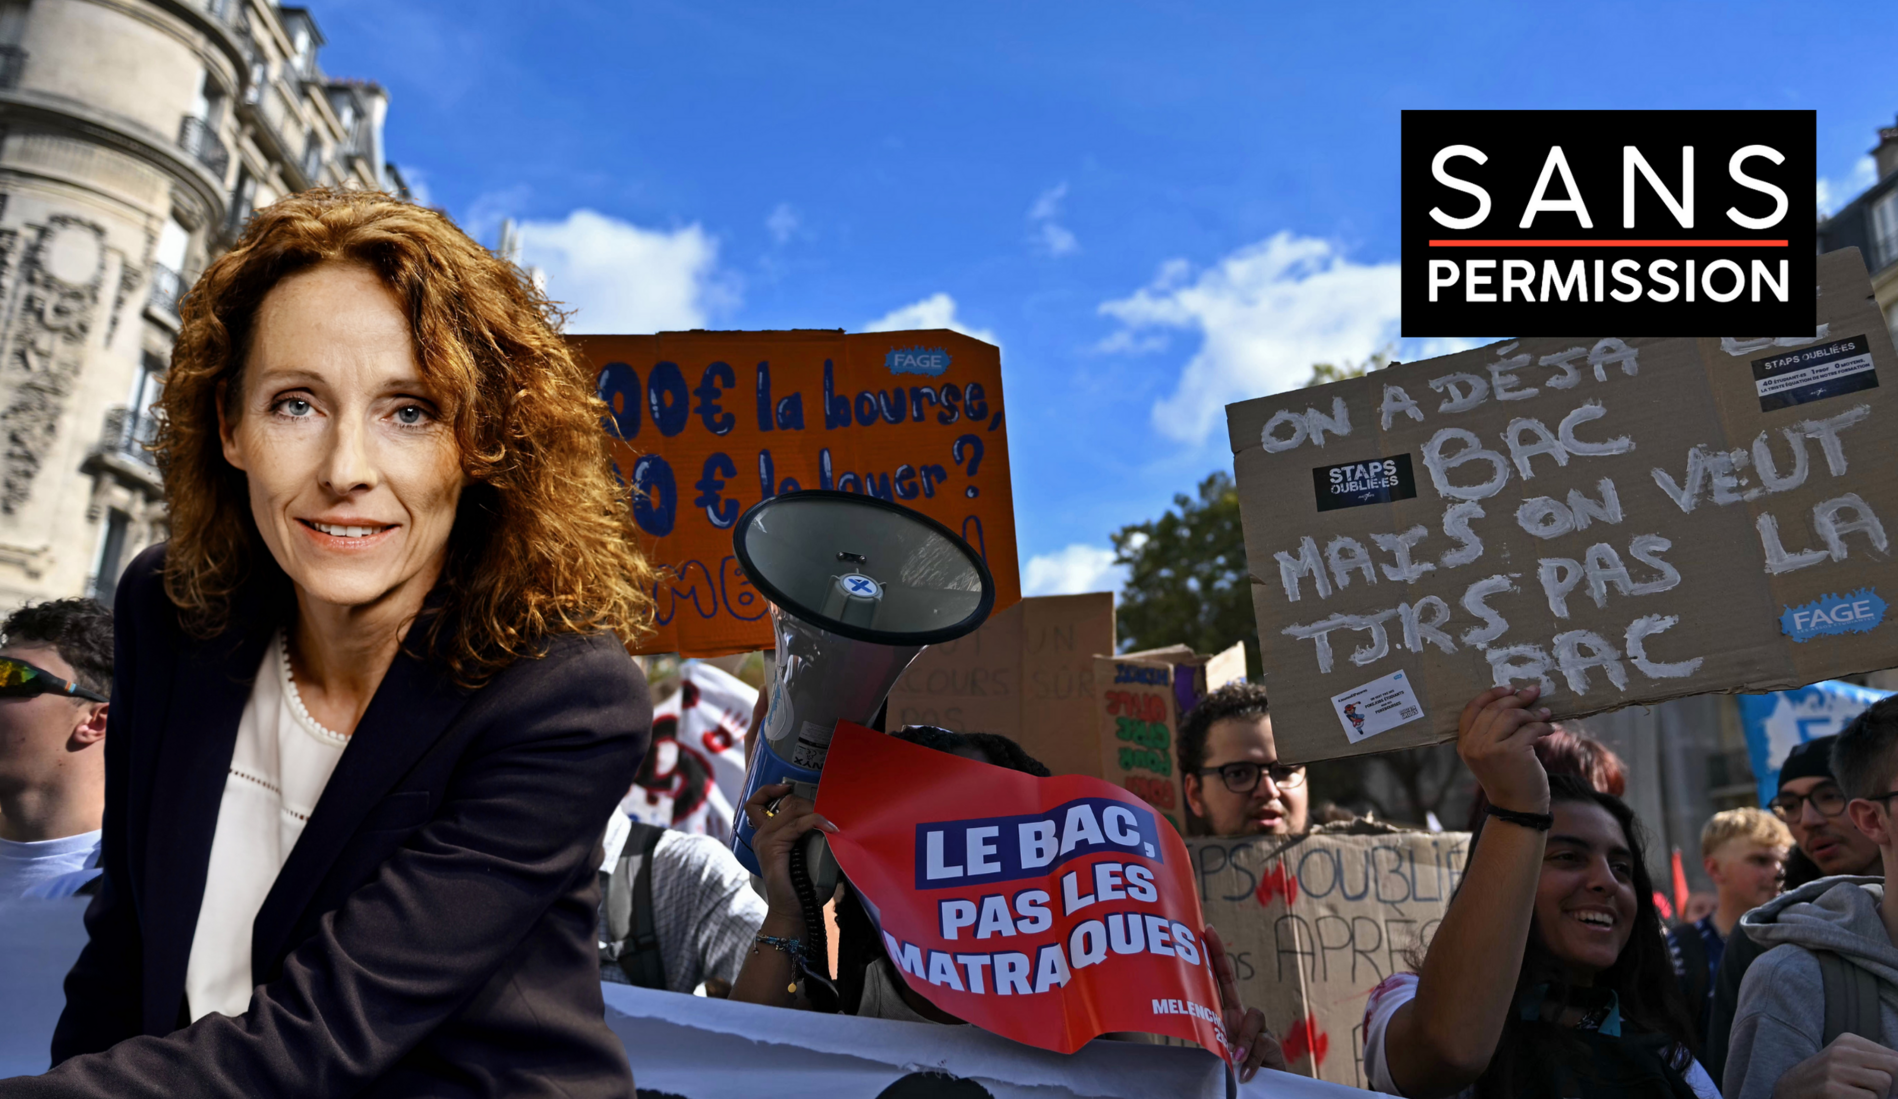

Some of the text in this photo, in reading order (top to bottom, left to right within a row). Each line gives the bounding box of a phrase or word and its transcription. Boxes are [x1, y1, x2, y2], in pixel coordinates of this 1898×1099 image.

[894, 354, 942, 368] FAGE
[1765, 356, 1799, 369] STAPS
[596, 358, 1002, 442] 00€ la bourse,
[1260, 396, 1351, 453] ON
[1380, 383, 1425, 431] A
[1329, 460, 1397, 484] STAPS
[1421, 399, 1637, 499] BAC
[1273, 405, 1871, 601] MAIS ON VEUT
[1537, 533, 1681, 618] PAS
[1756, 492, 1889, 575] LA
[1793, 600, 1875, 630] FAGE
[898, 666, 1011, 697] COURS
[1486, 613, 1702, 696] BAC
[926, 804, 1156, 881] LE BAC,
[941, 862, 1158, 941] PAS LES
